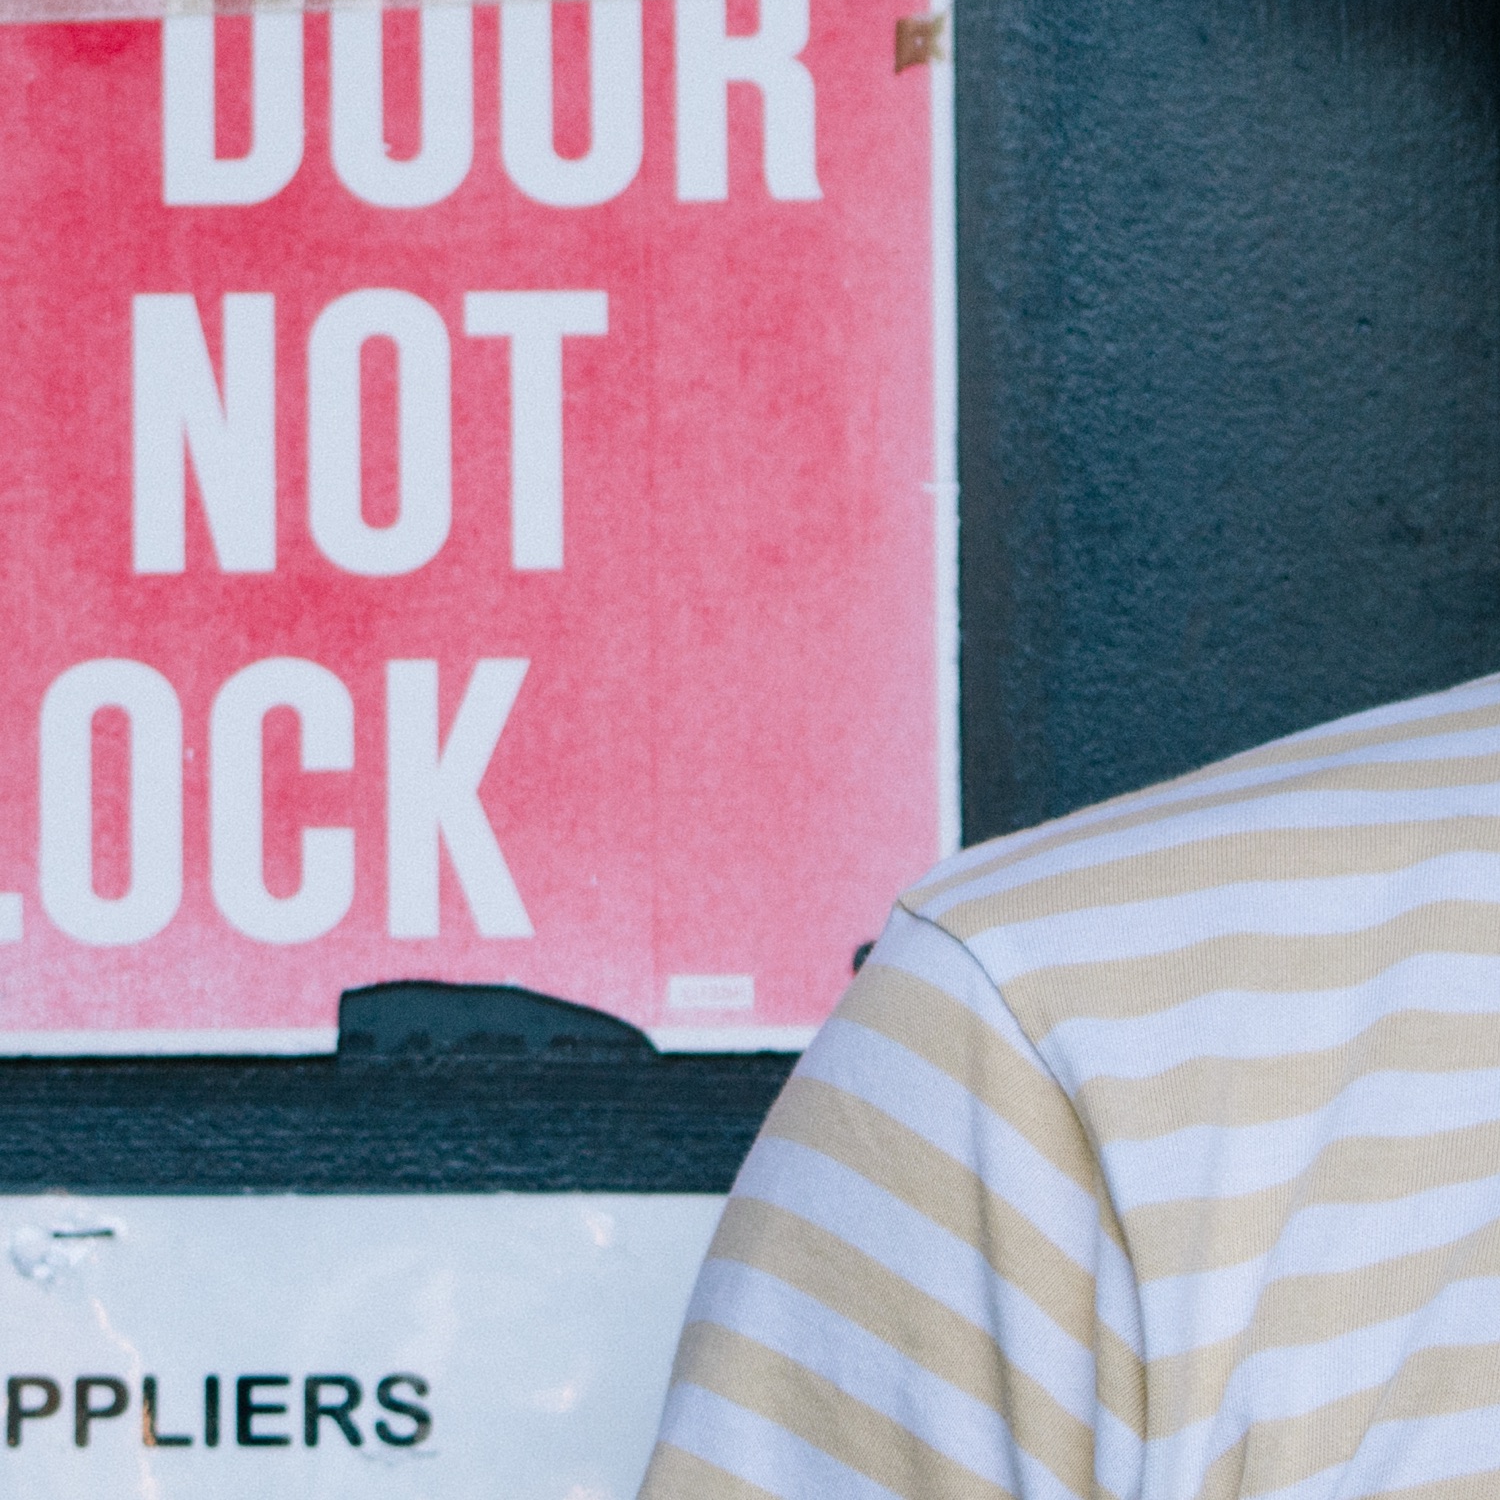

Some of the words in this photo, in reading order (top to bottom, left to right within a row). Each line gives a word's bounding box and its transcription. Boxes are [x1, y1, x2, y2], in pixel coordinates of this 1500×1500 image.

[131, 287, 608, 577] NOT
[0, 656, 536, 946] OCK
[5, 1372, 434, 1448] PPLIERS
